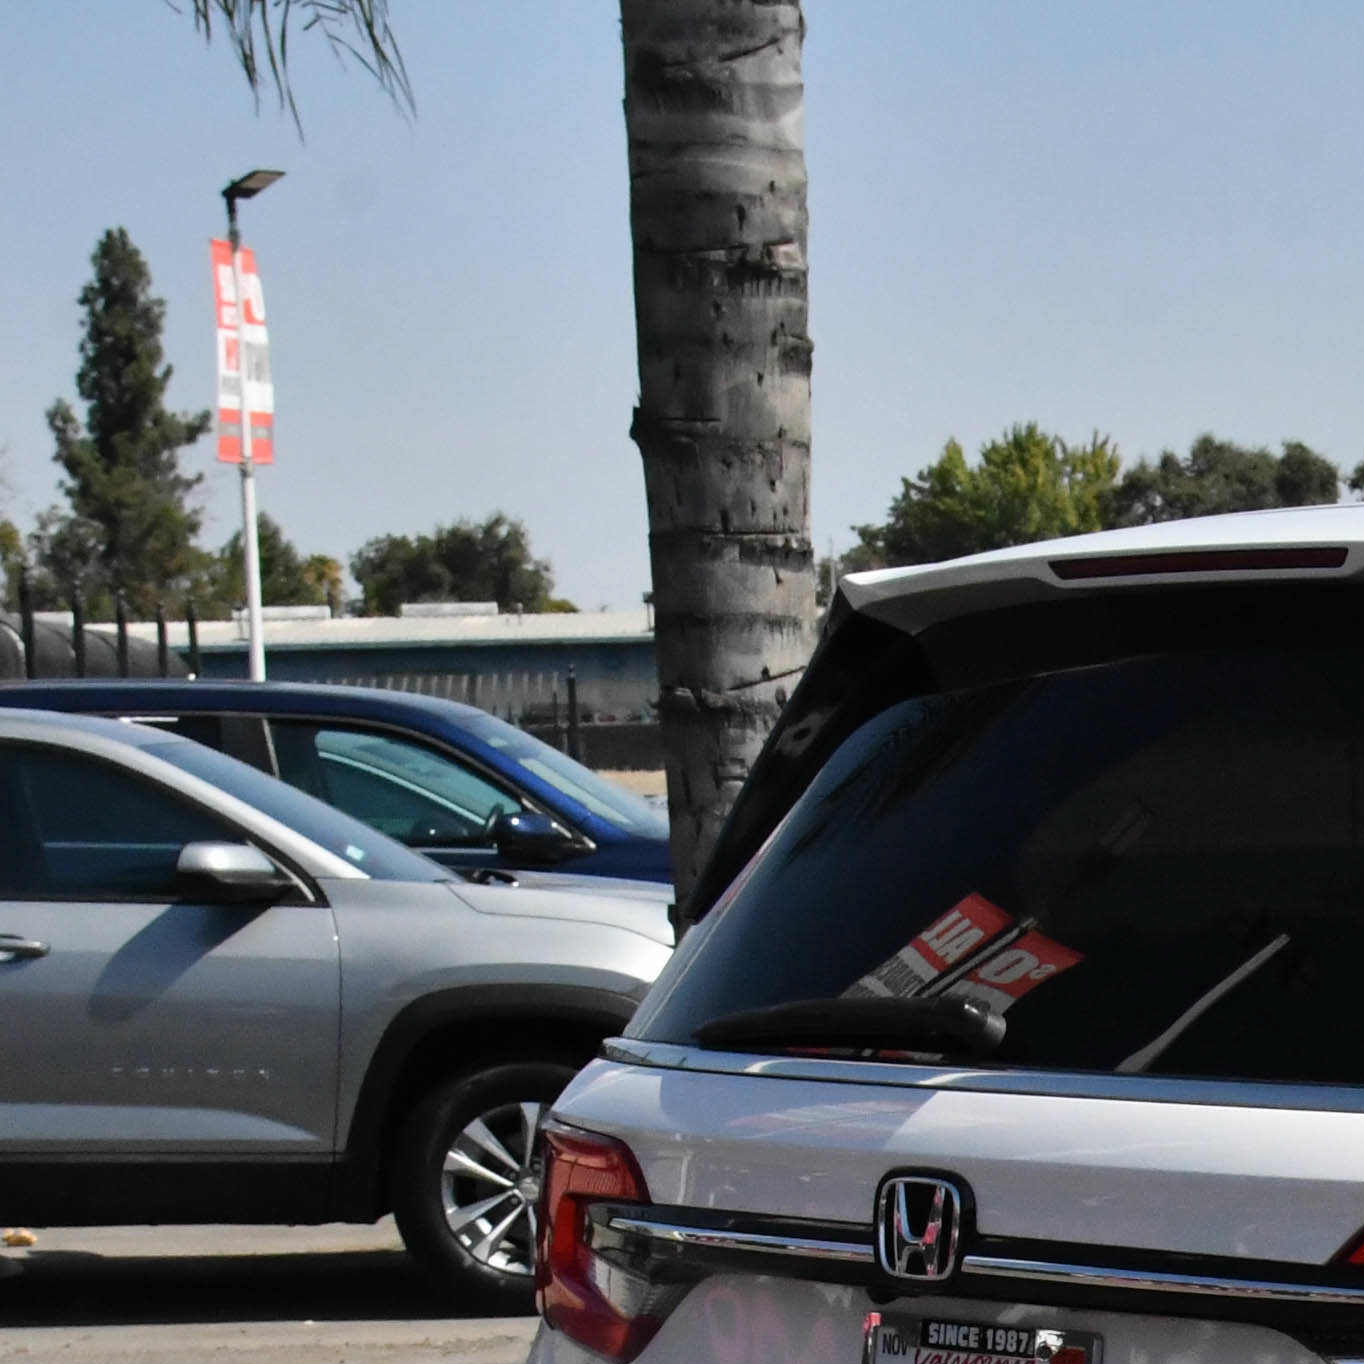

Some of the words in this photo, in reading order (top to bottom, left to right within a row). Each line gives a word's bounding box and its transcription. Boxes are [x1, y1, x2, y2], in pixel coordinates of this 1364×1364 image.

[882, 1333, 907, 1356] NOV
[928, 1322, 979, 1348] SINCE
[986, 1328, 1029, 1352] 1987
